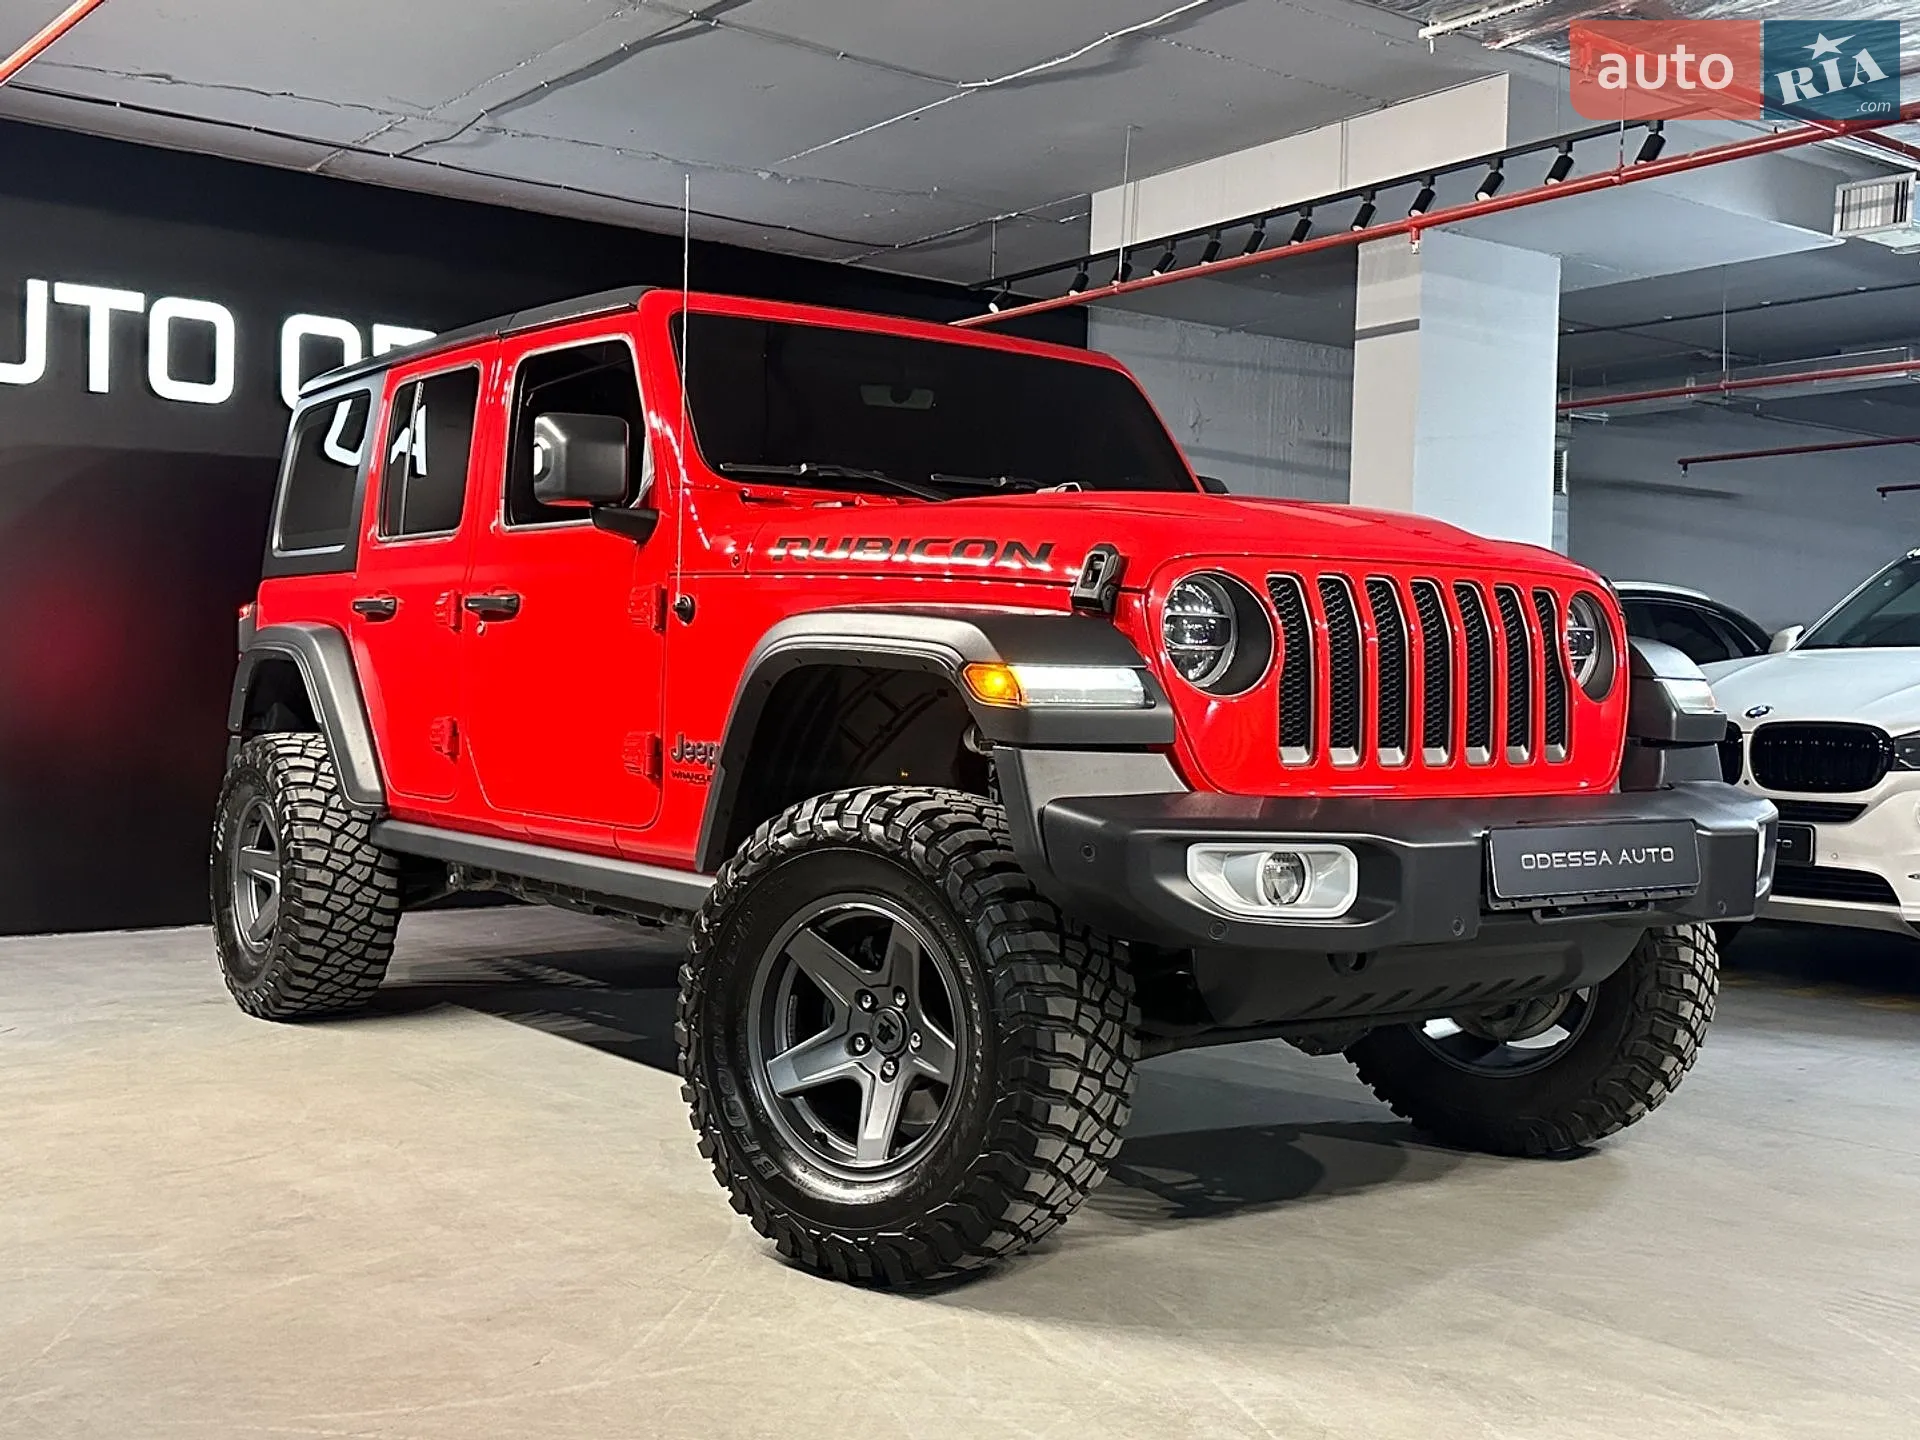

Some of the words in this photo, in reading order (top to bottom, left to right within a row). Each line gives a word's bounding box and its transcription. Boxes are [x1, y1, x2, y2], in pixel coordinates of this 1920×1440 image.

[774, 537, 1055, 571] RUBICON
[671, 733, 719, 770] Jeep
[1521, 850, 1612, 870] ODESSA
[1619, 846, 1675, 865] AUTO
